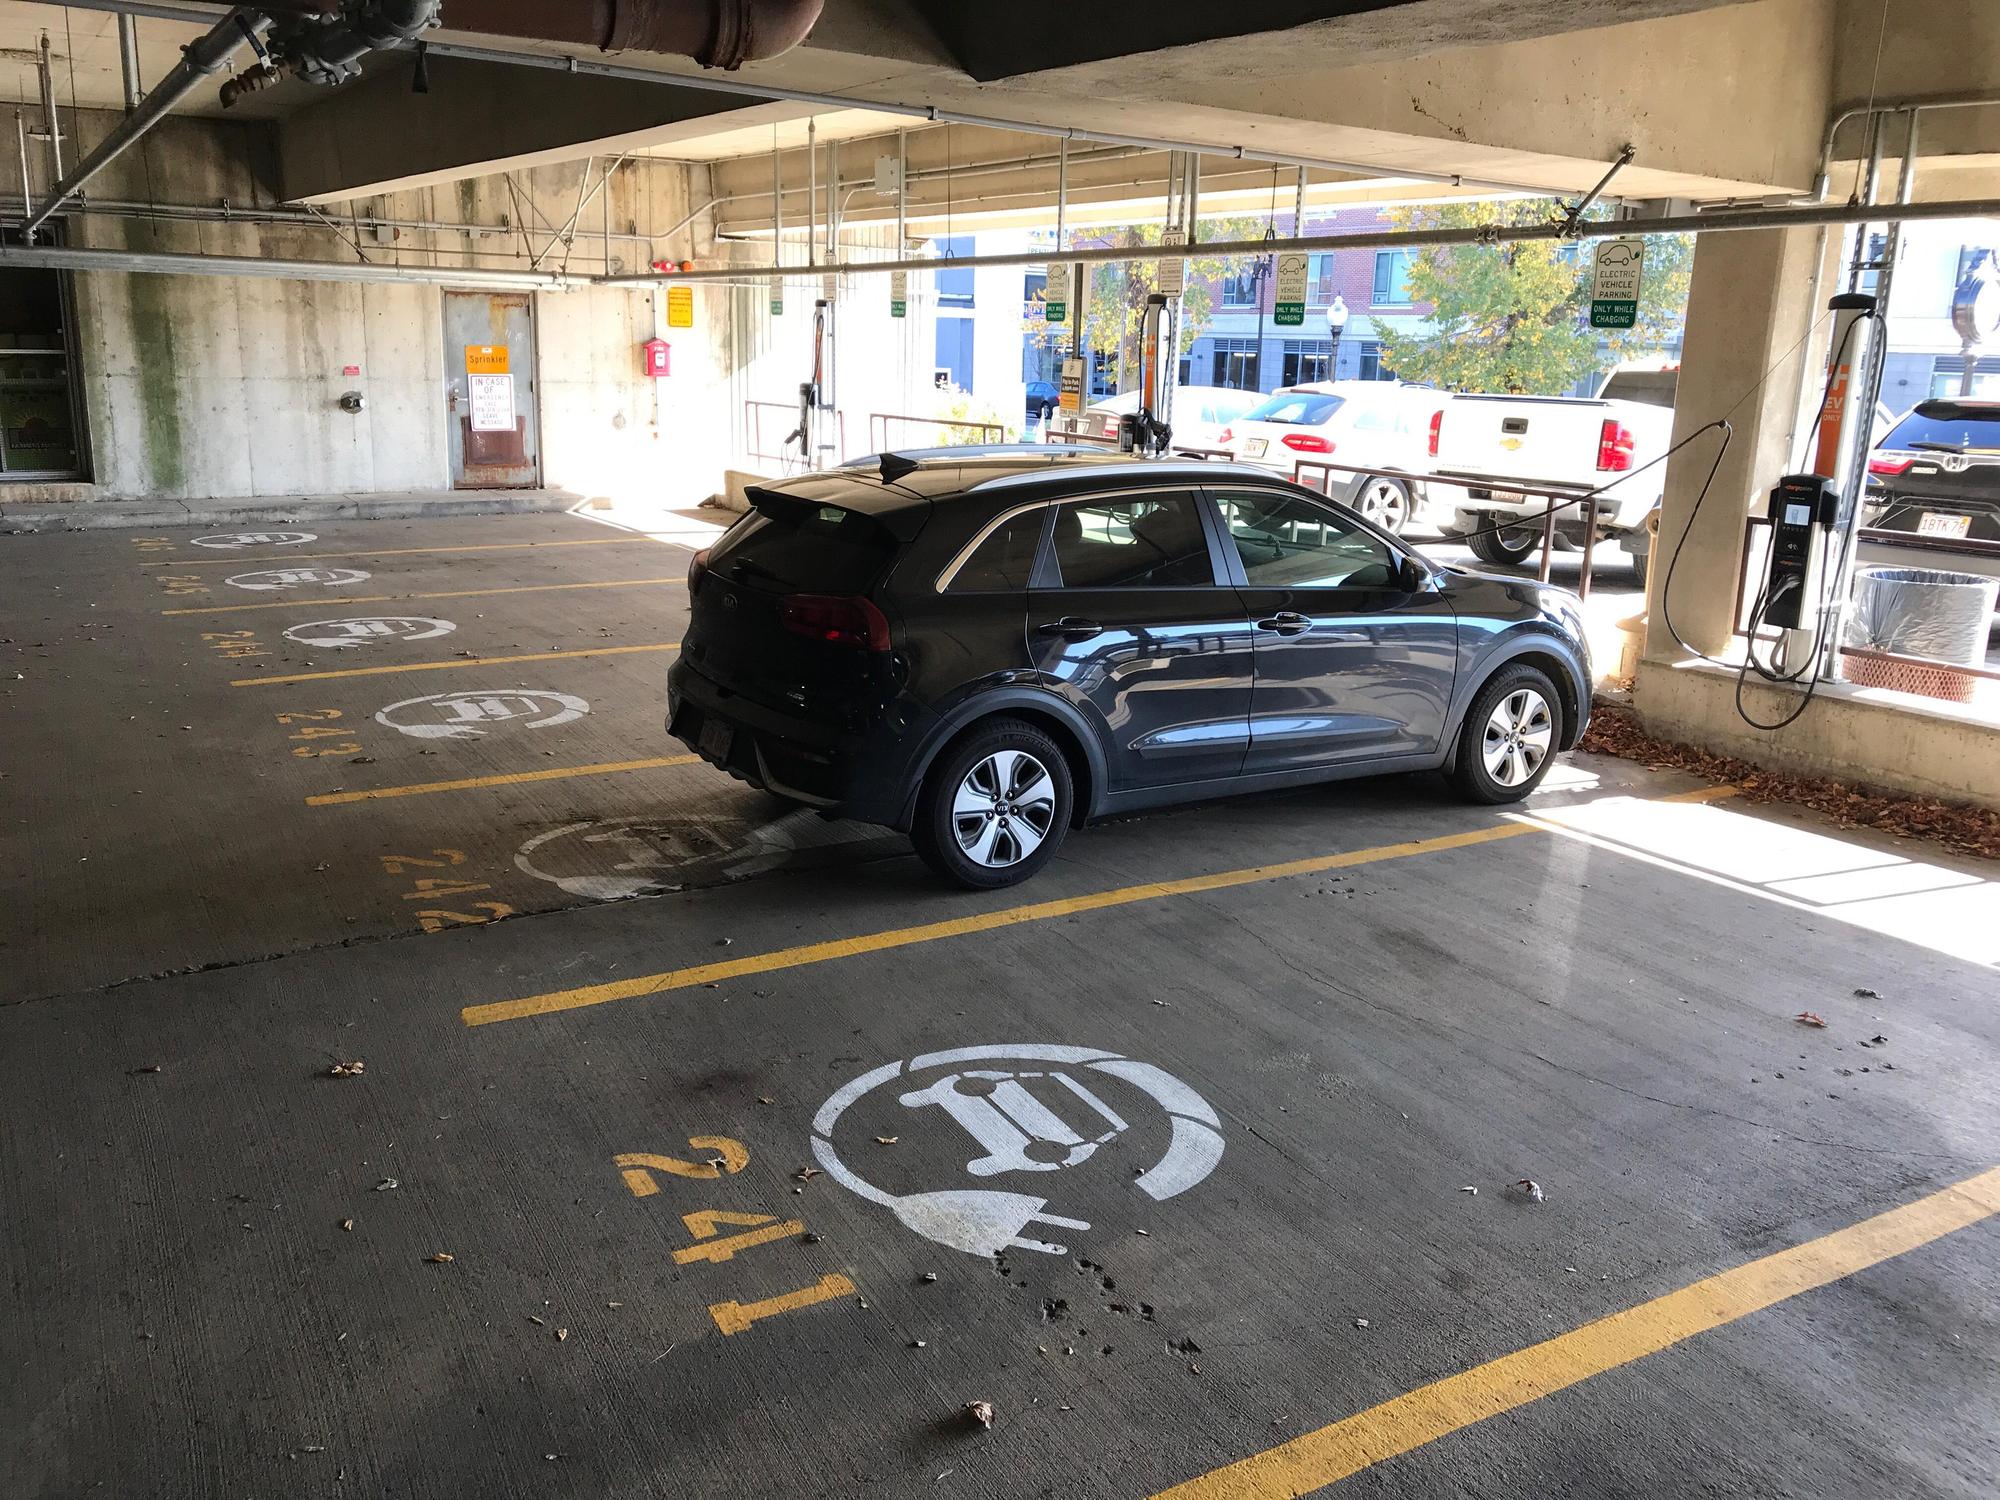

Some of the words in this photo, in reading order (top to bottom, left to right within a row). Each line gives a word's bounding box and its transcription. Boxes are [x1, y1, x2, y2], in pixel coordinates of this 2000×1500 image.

[1600, 270, 1636, 278] ELECTRIC
[1601, 281, 1633, 289] VEHICLE
[1599, 291, 1632, 299] PARKING
[1594, 305, 1611, 313] ONLY
[1614, 305, 1634, 313] WHILE
[1595, 315, 1630, 323] CHARGING
[469, 355, 506, 364] Sprinkler
[485, 378, 505, 386] CASE
[484, 386, 494, 394] OF
[1824, 396, 1843, 409] EV
[1822, 414, 1841, 422] ONLY
[379, 849, 515, 934] 242
[612, 1135, 857, 1337] 241
